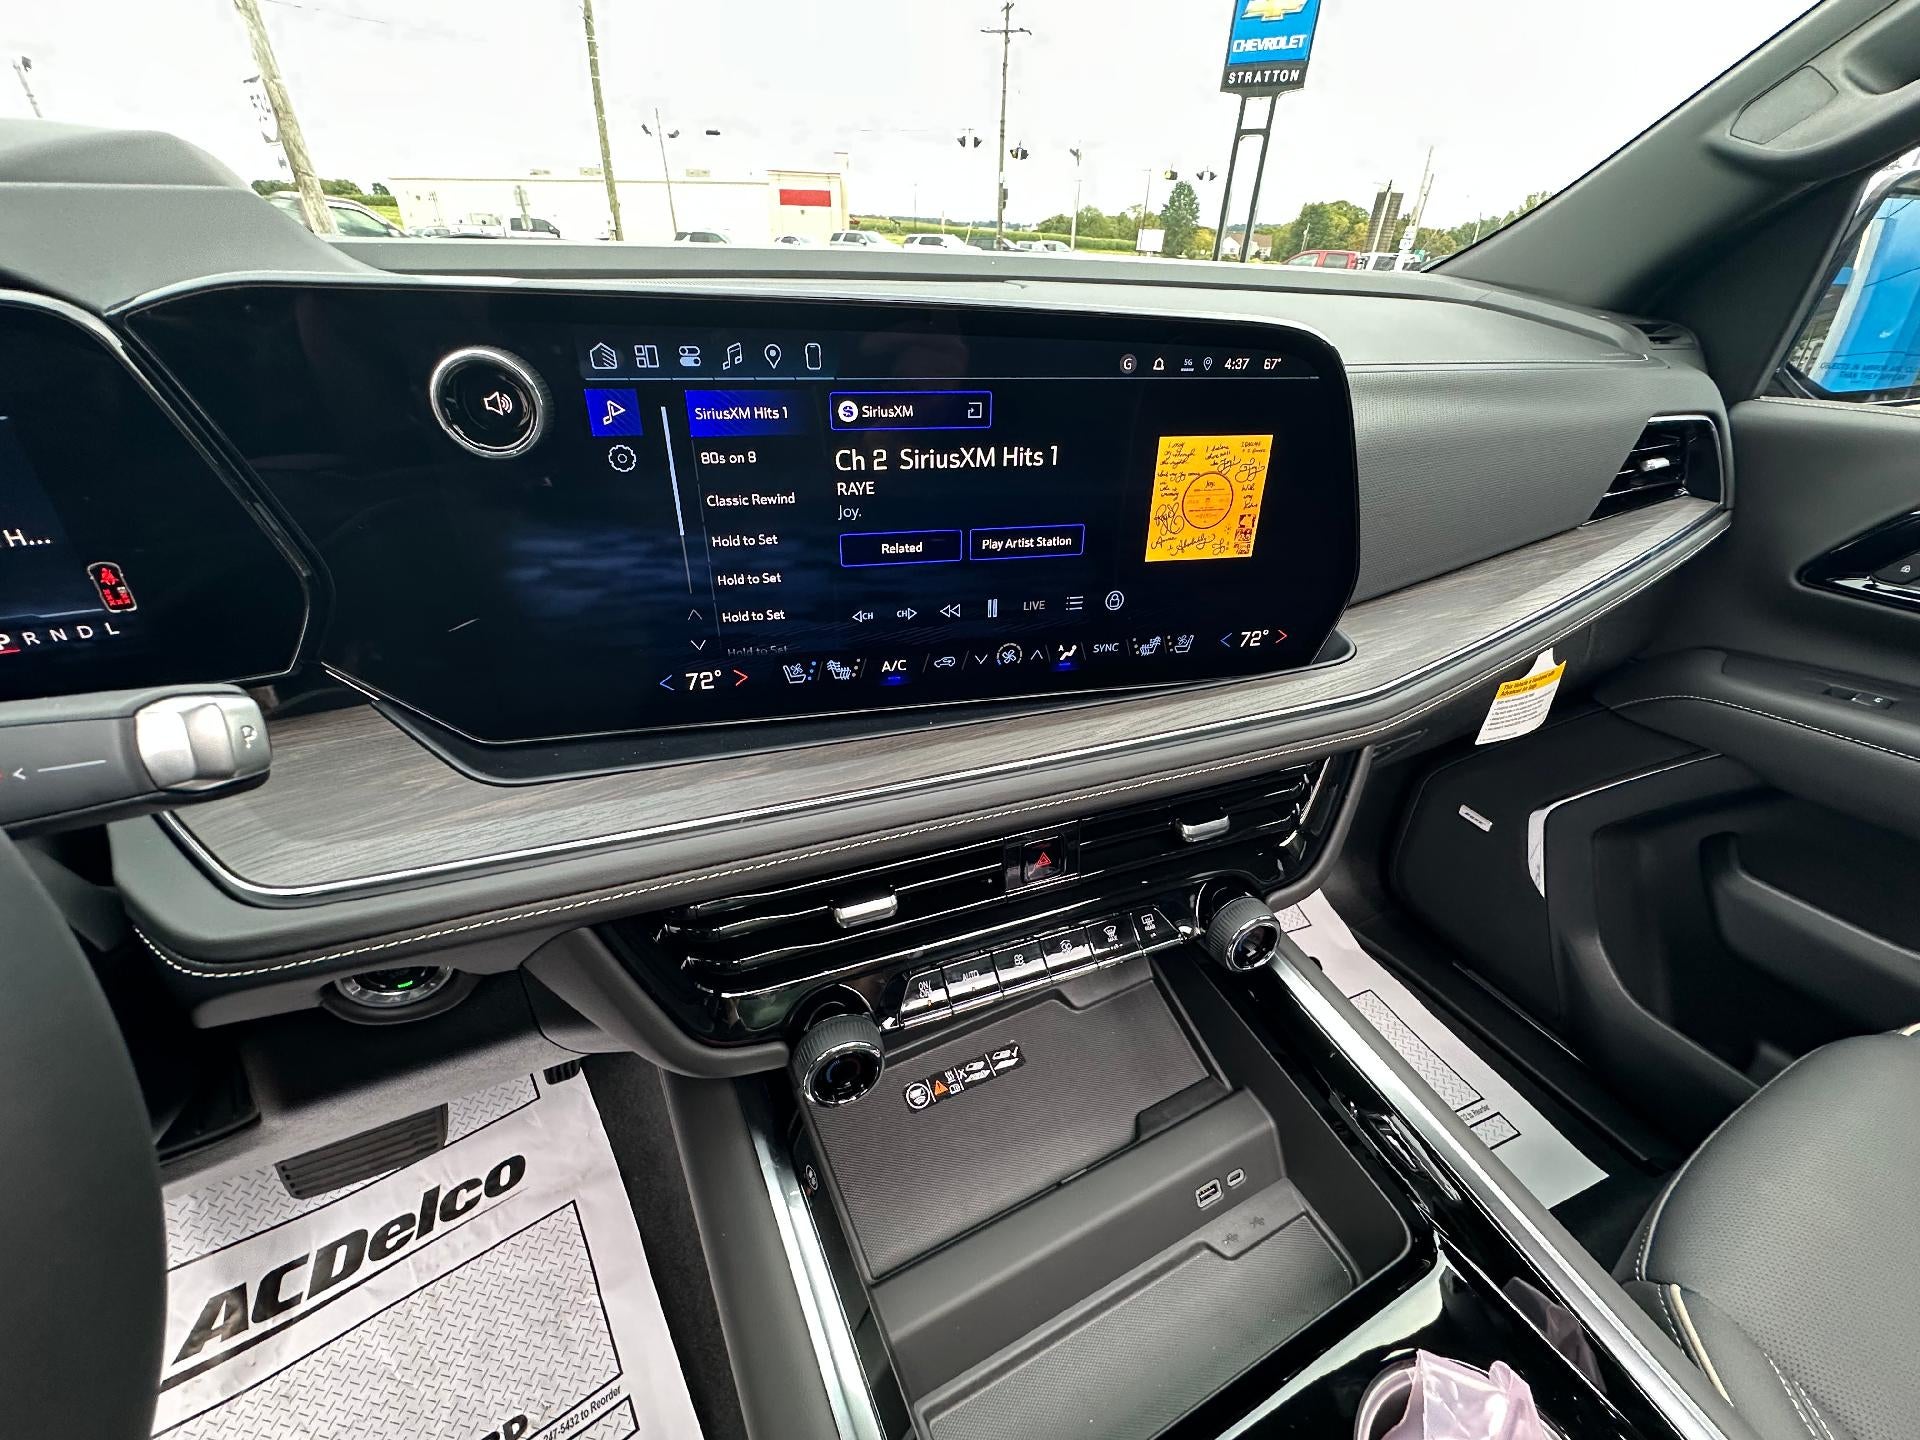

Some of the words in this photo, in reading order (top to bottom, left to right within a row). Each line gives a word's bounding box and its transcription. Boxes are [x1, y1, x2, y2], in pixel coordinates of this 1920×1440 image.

[1232, 34, 1307, 53] CHEVROLET
[1228, 69, 1300, 84] STRATTON
[1224, 357, 1250, 370] 4:37
[695, 407, 751, 421] SiriusXM
[754, 406, 780, 420] Hits
[782, 406, 788, 419] 1
[862, 405, 913, 418] SiriusXM
[700, 451, 725, 465] 80s
[729, 453, 745, 464] on
[747, 451, 757, 464] 8
[835, 450, 866, 471] Ch
[872, 449, 888, 470] 2
[899, 447, 996, 470] SiriusXM
[1003, 447, 1044, 468] Hits
[1049, 446, 1058, 466] 1
[836, 482, 875, 496] RAYE
[706, 494, 749, 508] Classic
[751, 491, 796, 506] Rewind
[837, 505, 862, 520] Joy.
[711, 534, 740, 547] Hold
[742, 534, 756, 546] to
[758, 533, 778, 546] Set
[982, 537, 1002, 551] Play
[1004, 535, 1034, 549] Artist
[1036, 533, 1072, 548] Station
[881, 542, 923, 554] Related
[717, 573, 744, 586] Hold
[746, 574, 760, 585] to
[762, 572, 782, 584] Set
[1023, 600, 1045, 611] LIVE
[722, 610, 749, 623] Hold
[751, 611, 764, 621] to
[766, 609, 786, 620] Set
[862, 612, 874, 620] CH
[897, 610, 908, 618] CH
[21, 631, 41, 646] R
[49, 628, 69, 643] N
[76, 624, 94, 639] D
[104, 621, 121, 636] L
[1239, 628, 1270, 648] 72°
[1093, 642, 1119, 653] SYNC
[881, 660, 907, 672] A/C
[685, 669, 722, 691] 72°
[962, 969, 980, 981] AUTO
[580, 1409, 589, 1420] to
[590, 1385, 622, 1413] Reorder
